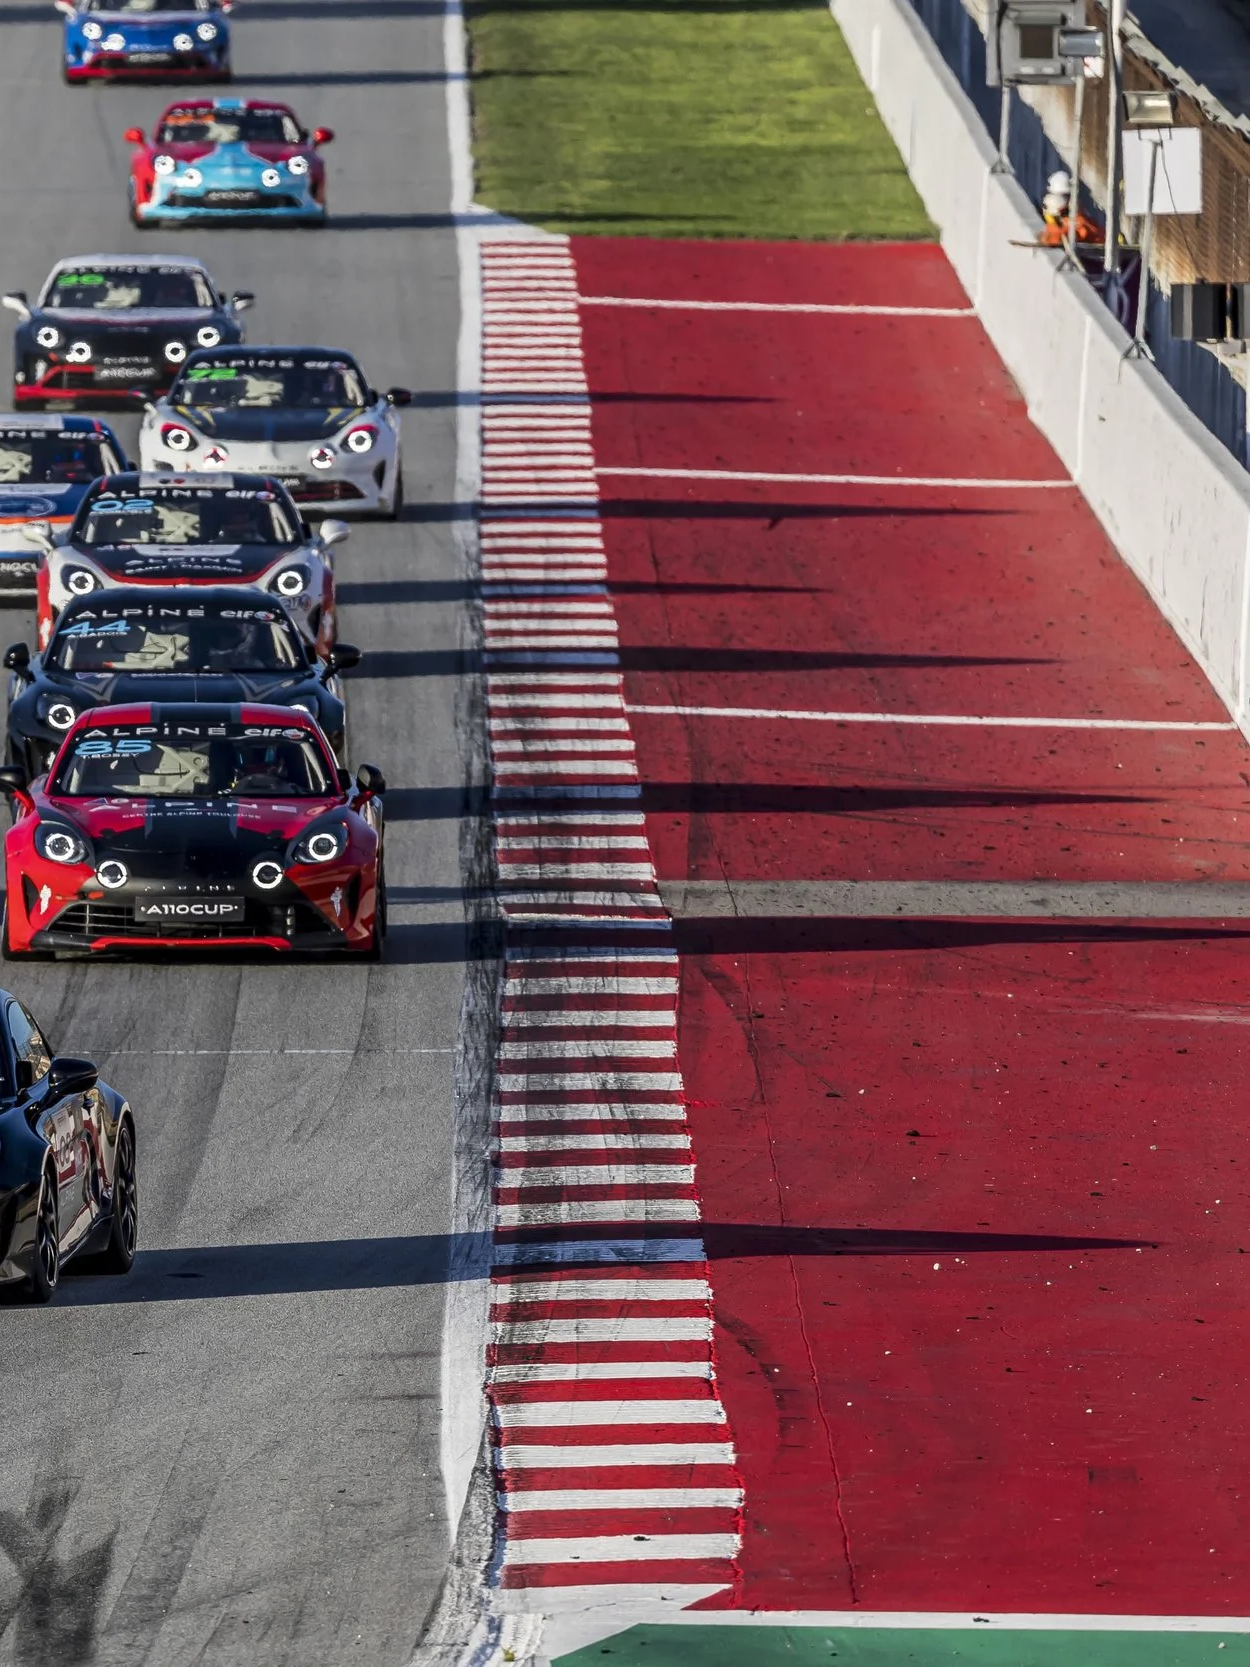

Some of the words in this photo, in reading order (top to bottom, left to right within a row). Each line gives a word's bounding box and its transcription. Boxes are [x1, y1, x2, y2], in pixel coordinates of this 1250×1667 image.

[194, 359, 294, 369] ALPINE
[97, 489, 213, 498] ALPINE
[225, 490, 256, 498] elf
[91, 499, 154, 511] 02
[125, 557, 242, 566] ALPINE
[75, 608, 205, 619] ALPINE
[220, 609, 254, 618] elf
[58, 619, 131, 635] 44
[84, 727, 226, 738] ALPINE
[244, 728, 282, 737] elf
[74, 739, 152, 755] 85
[88, 801, 297, 813] ALPINE
[146, 904, 234, 915] A110CUP
